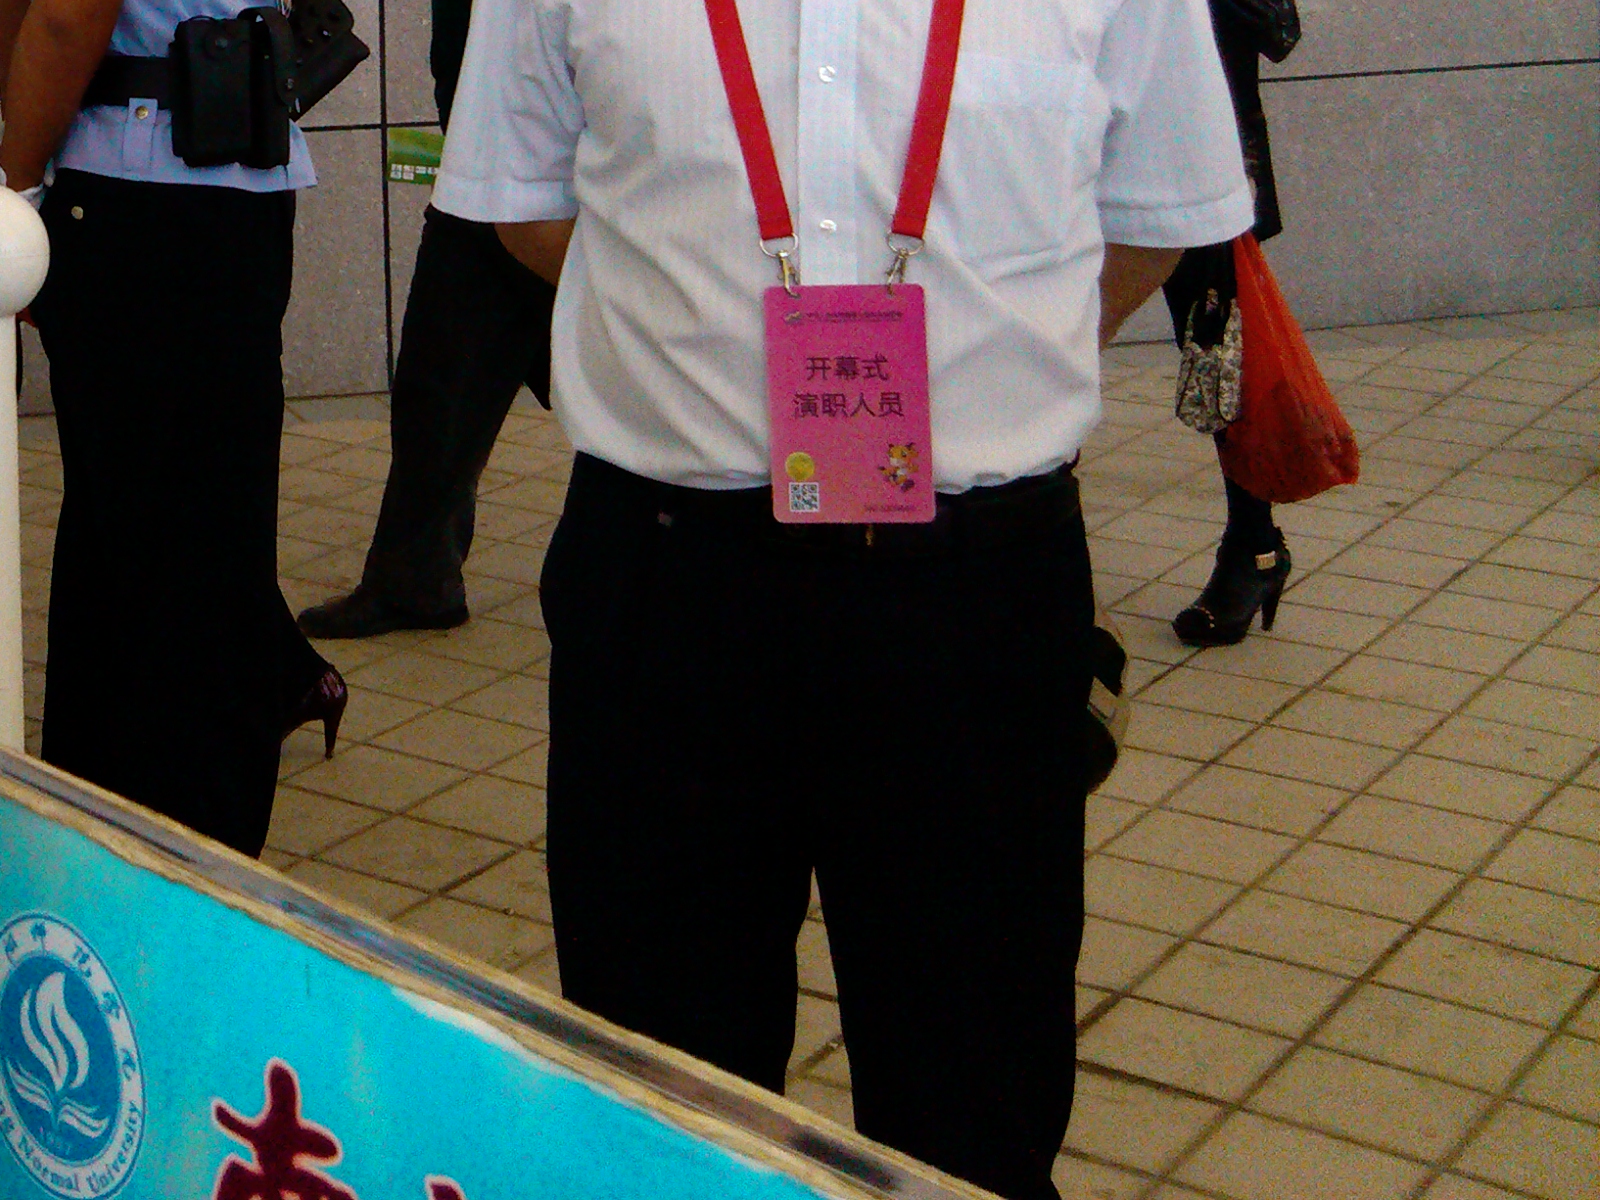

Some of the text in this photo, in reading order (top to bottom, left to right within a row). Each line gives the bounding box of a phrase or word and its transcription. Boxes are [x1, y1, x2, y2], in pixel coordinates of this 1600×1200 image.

[806, 354, 888, 381] 开幕式
[793, 392, 904, 418] 演职人员
[85, 1100, 141, 1194] University
